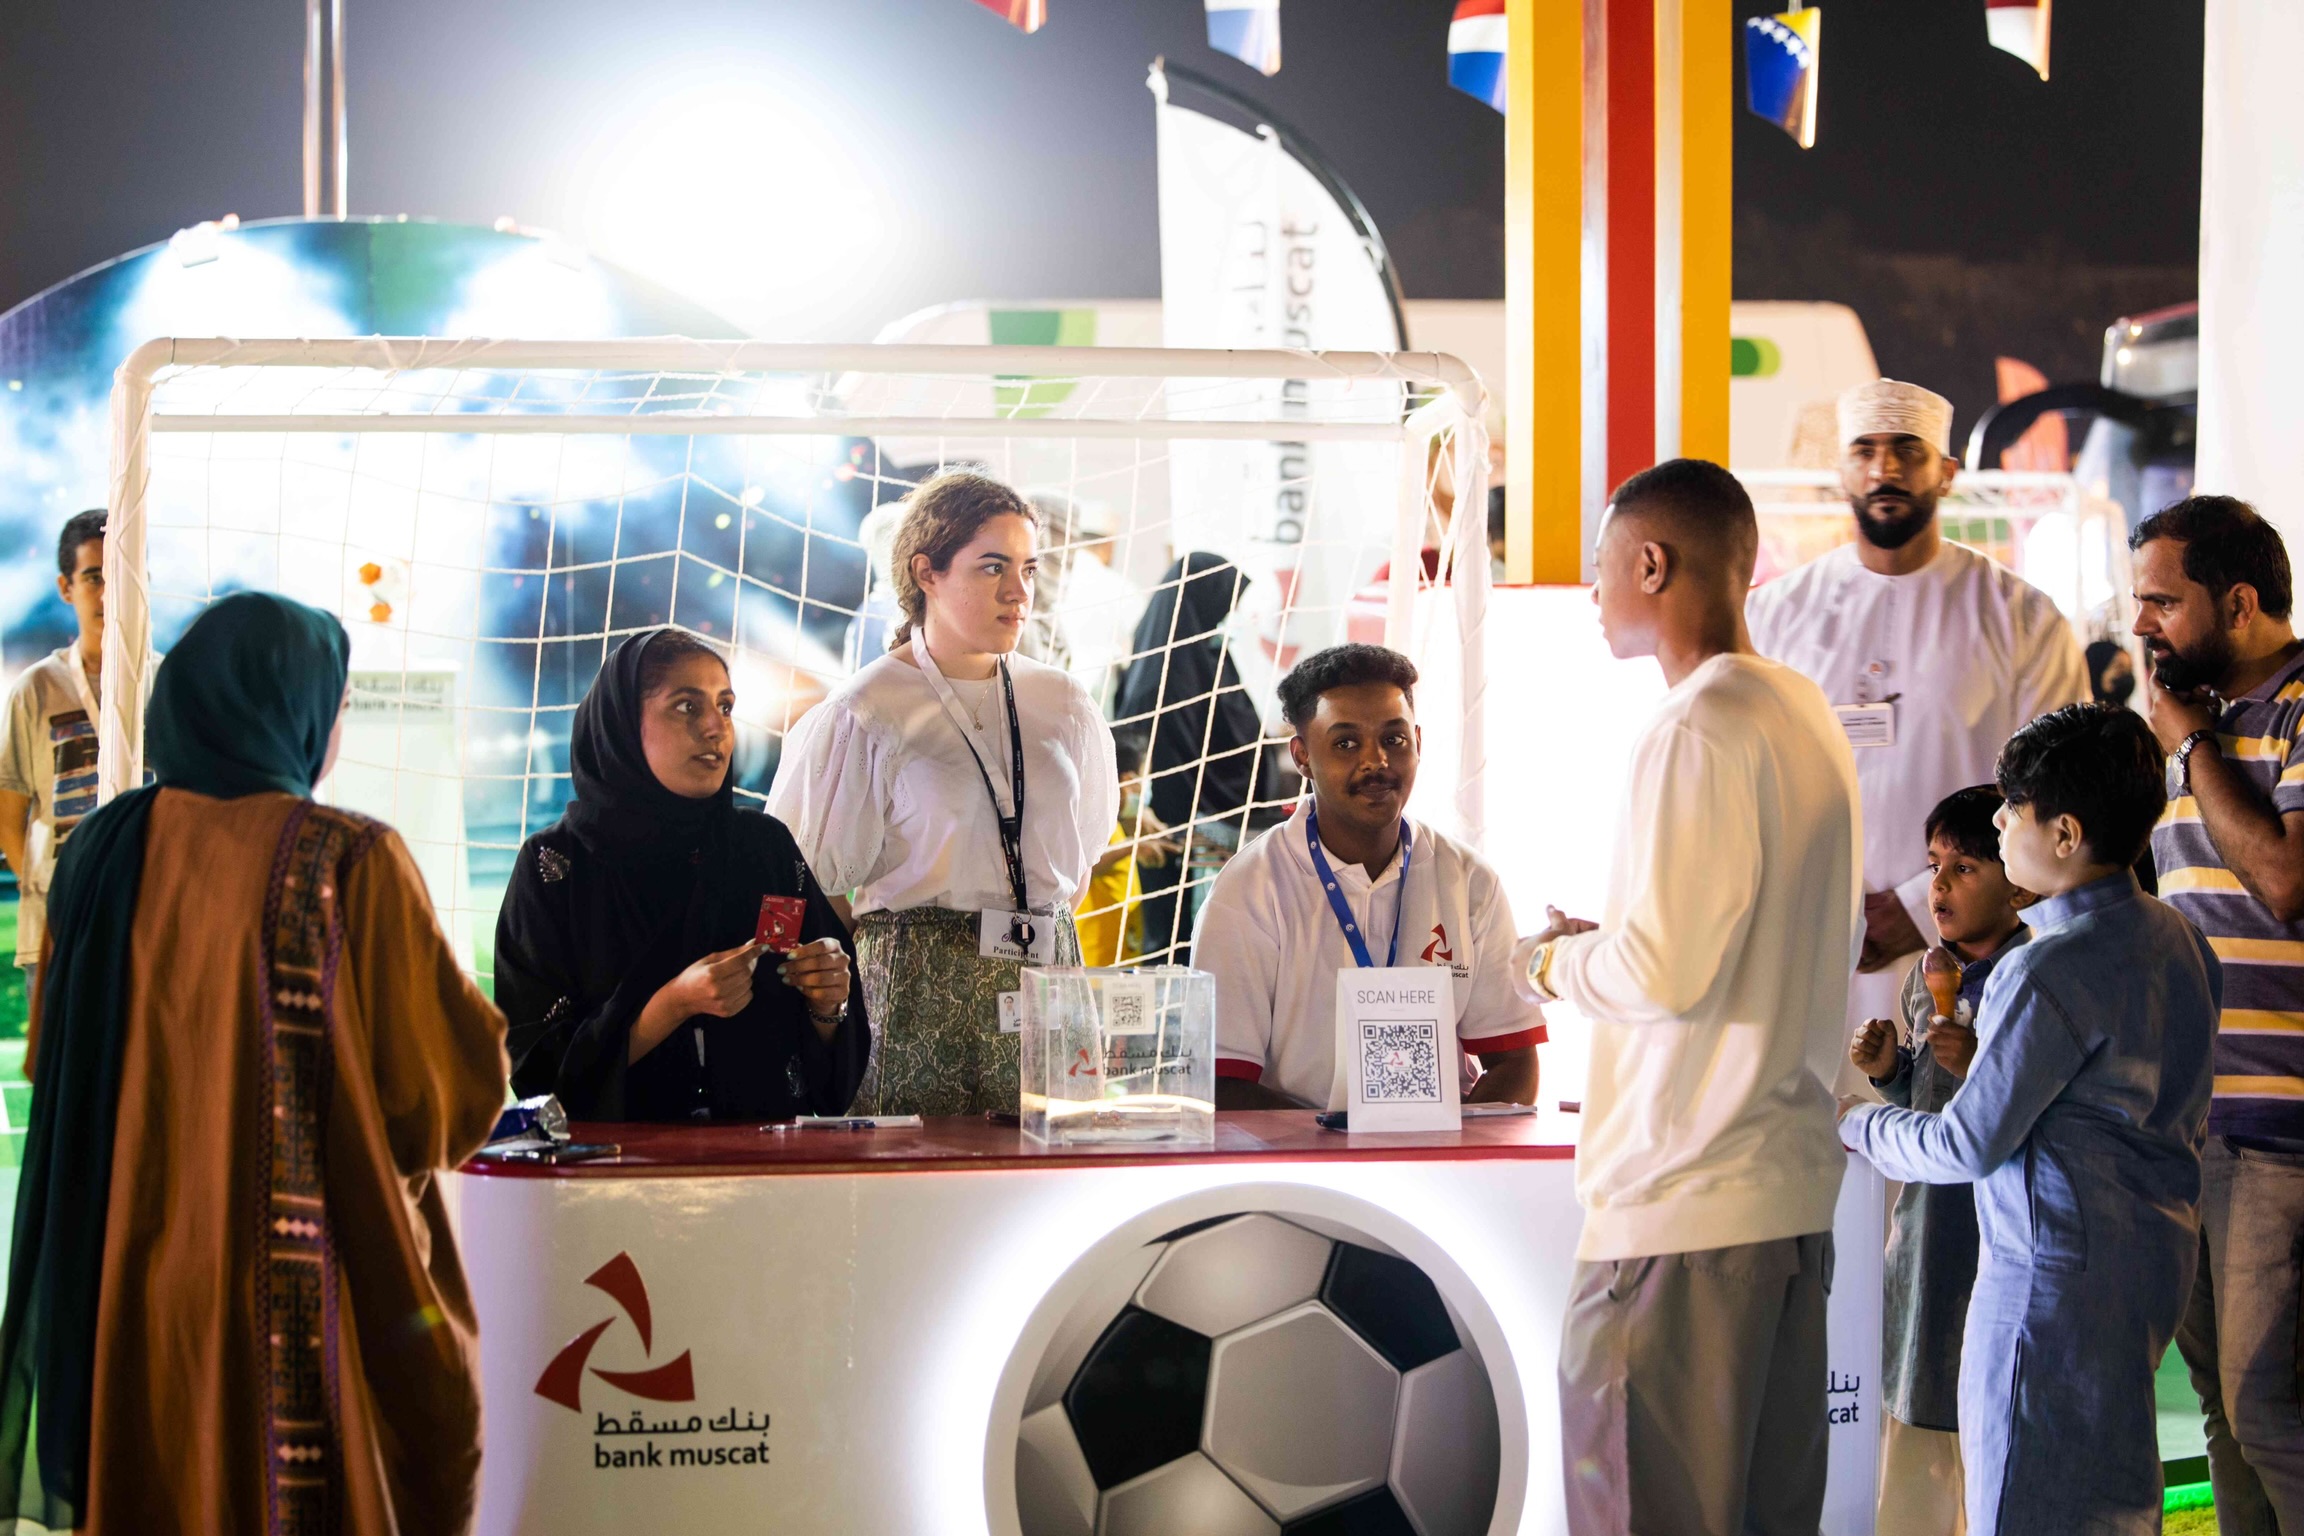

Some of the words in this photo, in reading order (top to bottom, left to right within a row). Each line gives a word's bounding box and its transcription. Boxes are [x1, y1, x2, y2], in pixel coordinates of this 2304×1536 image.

[1357, 990, 1395, 1004] SCAN
[1399, 990, 1435, 1004] HERE
[1103, 1063, 1137, 1076] bank
[1141, 1064, 1191, 1076] muscat
[594, 1411, 702, 1435] مسقط
[709, 1407, 770, 1437] بنك
[595, 1441, 662, 1468] bank
[670, 1441, 769, 1466] muscat
